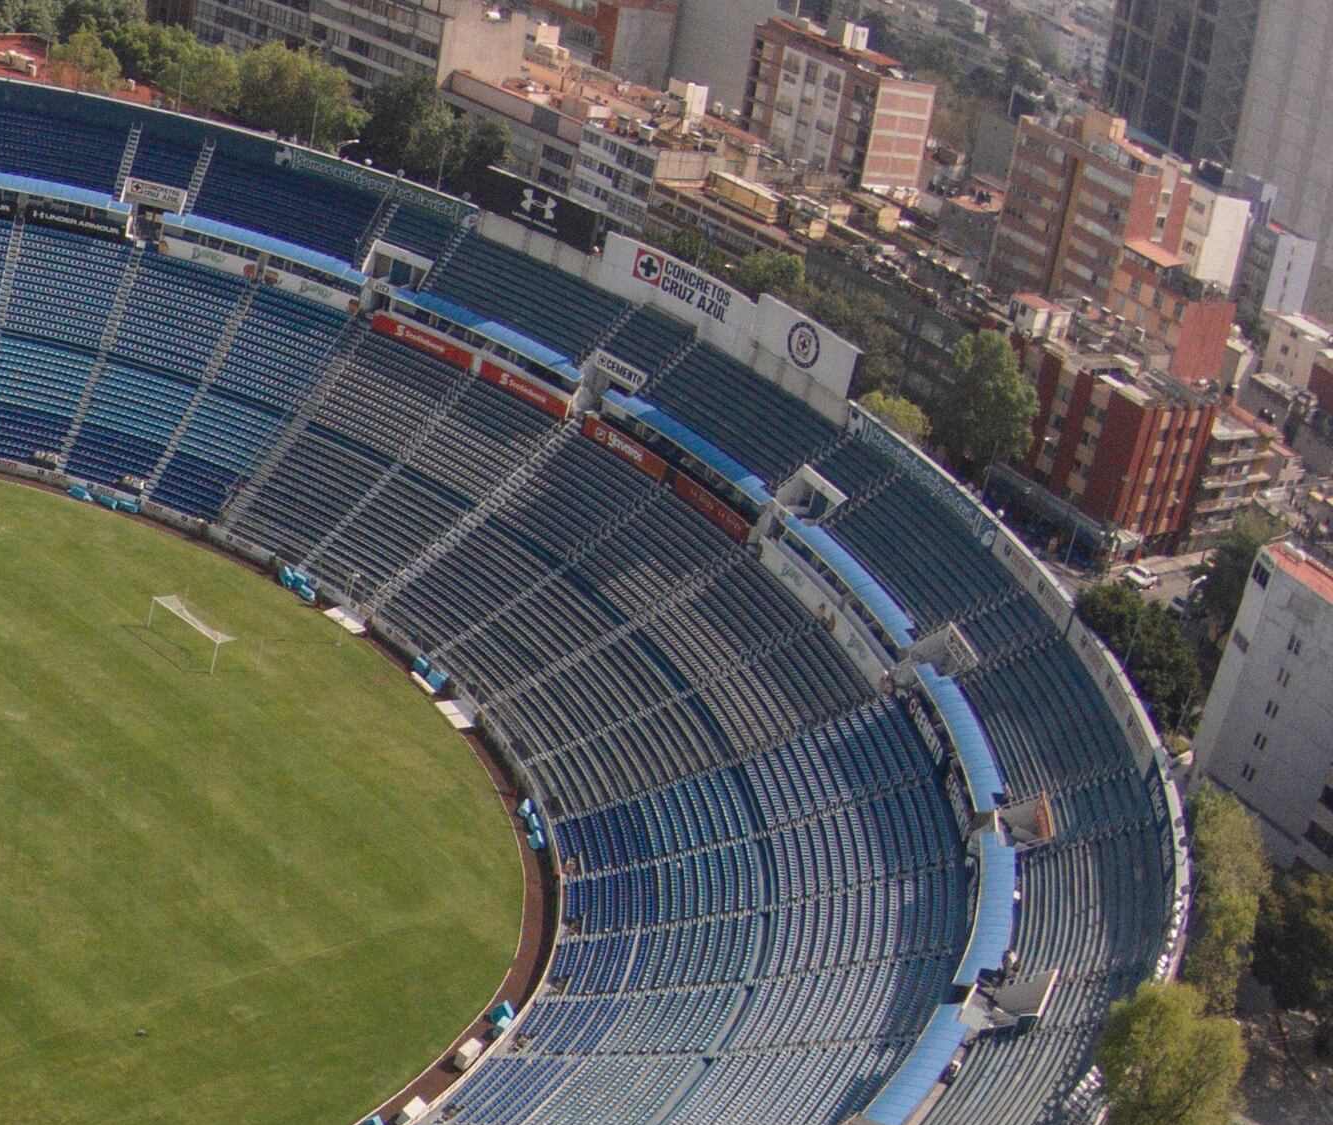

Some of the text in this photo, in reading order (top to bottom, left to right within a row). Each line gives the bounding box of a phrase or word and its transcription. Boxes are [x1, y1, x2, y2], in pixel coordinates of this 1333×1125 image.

[661, 277, 727, 325] CRUZ AZUL
[664, 260, 732, 307] CONCRETOS
[605, 359, 643, 386] CEMENTO
